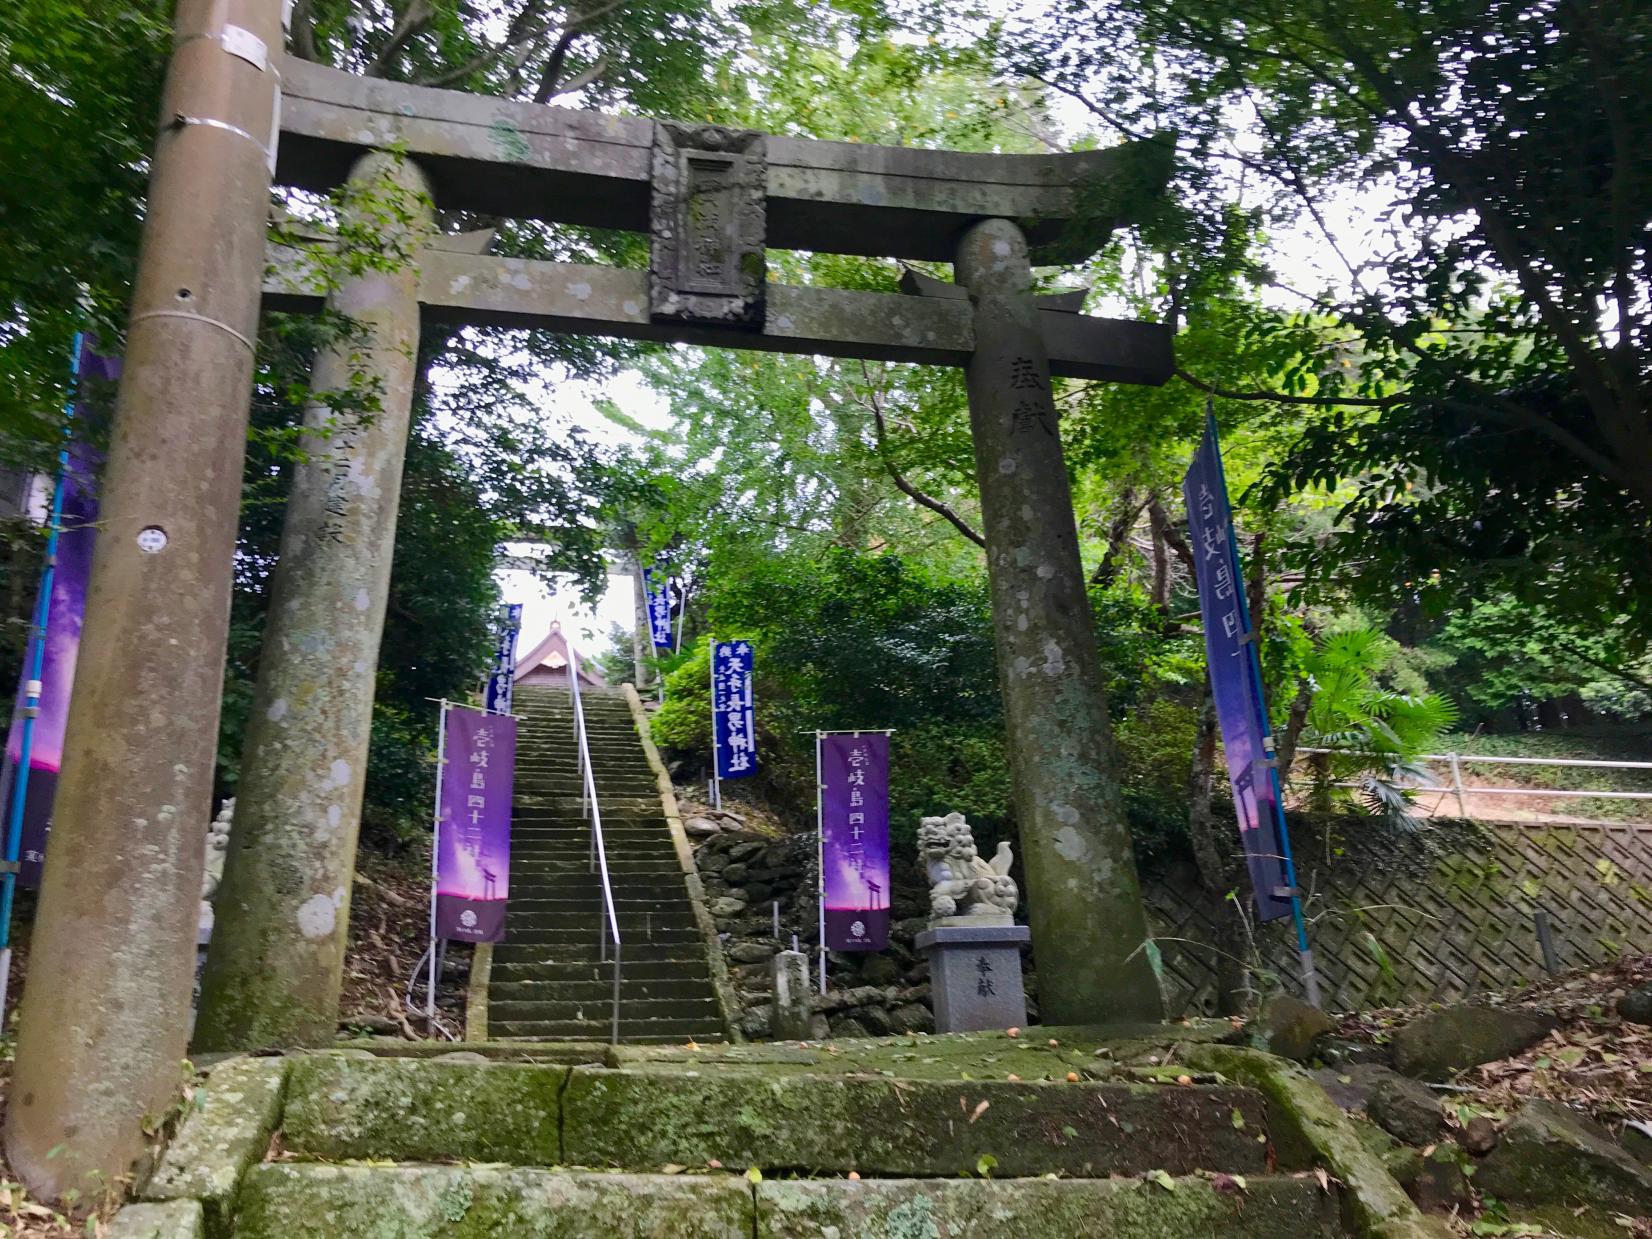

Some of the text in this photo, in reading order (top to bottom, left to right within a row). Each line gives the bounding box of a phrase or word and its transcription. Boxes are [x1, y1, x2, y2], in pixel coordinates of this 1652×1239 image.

[724, 657, 751, 772] 天手長男神社
